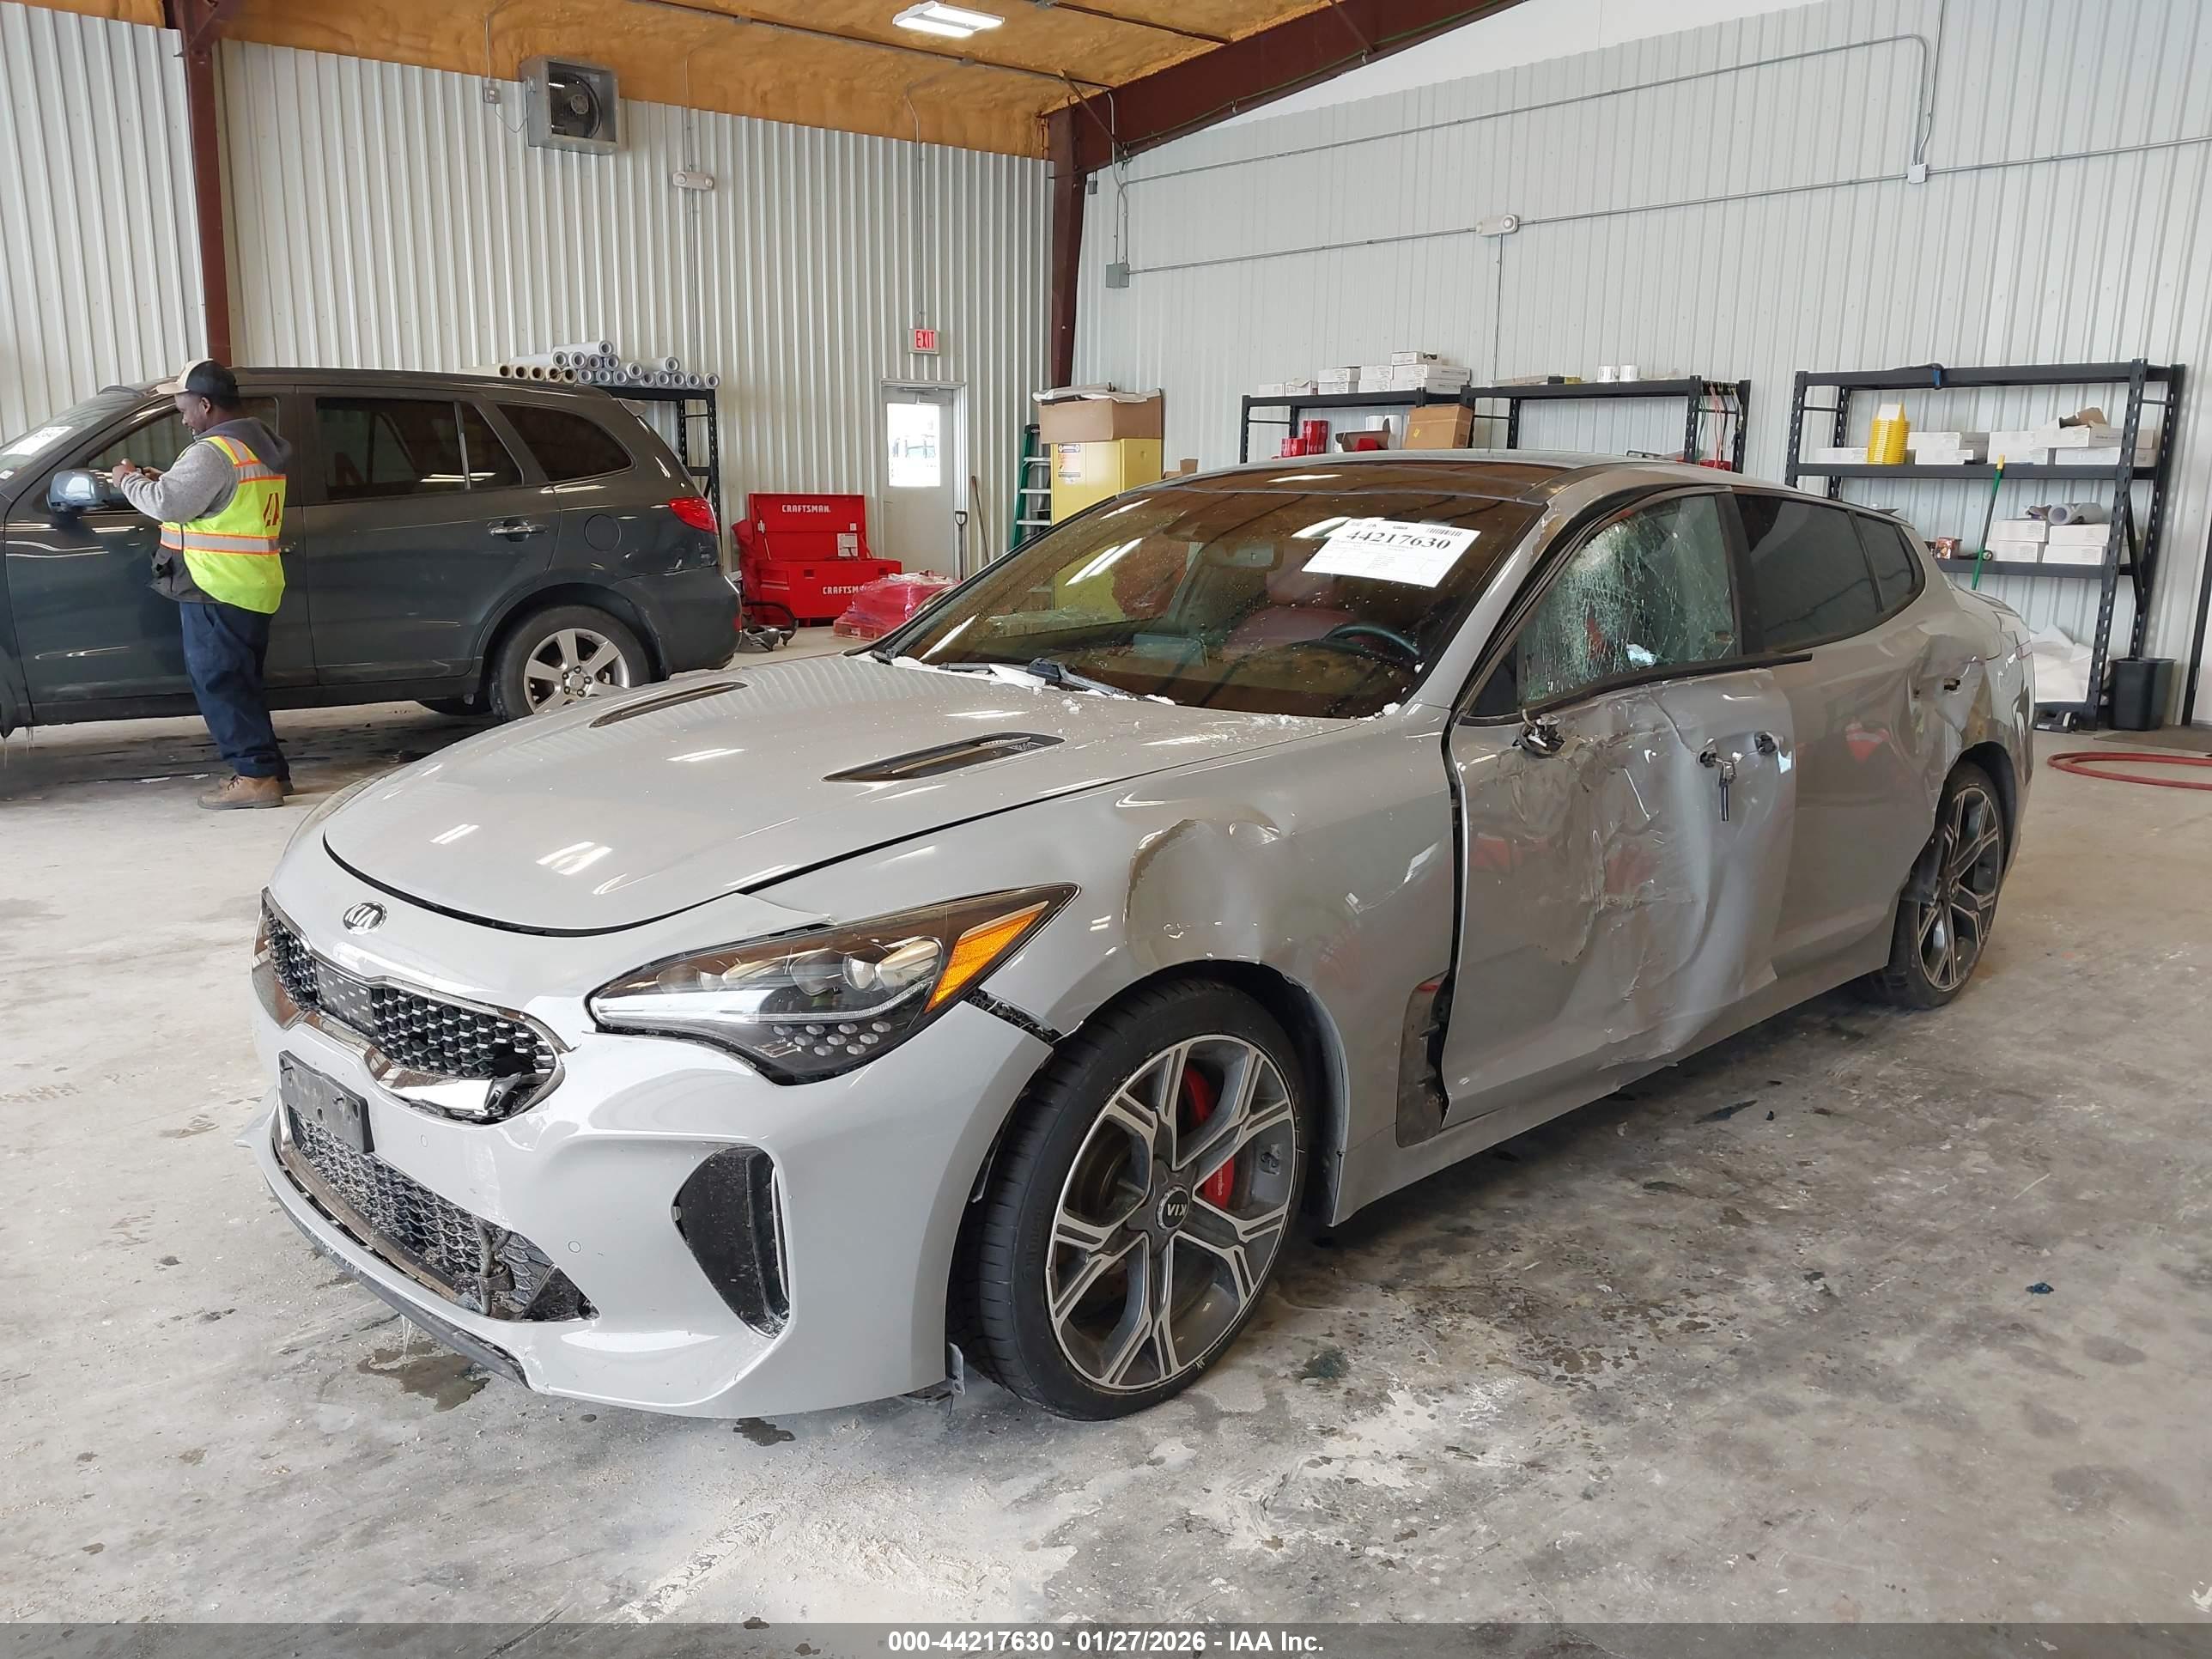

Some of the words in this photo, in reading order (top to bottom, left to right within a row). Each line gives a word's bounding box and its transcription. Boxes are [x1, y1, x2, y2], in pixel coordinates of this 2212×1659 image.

[915, 331, 935, 349] EXIT
[781, 504, 830, 513] CRAFTSMAN
[1346, 530, 1452, 550] 44217630
[822, 586, 860, 594] CRAFTSM
